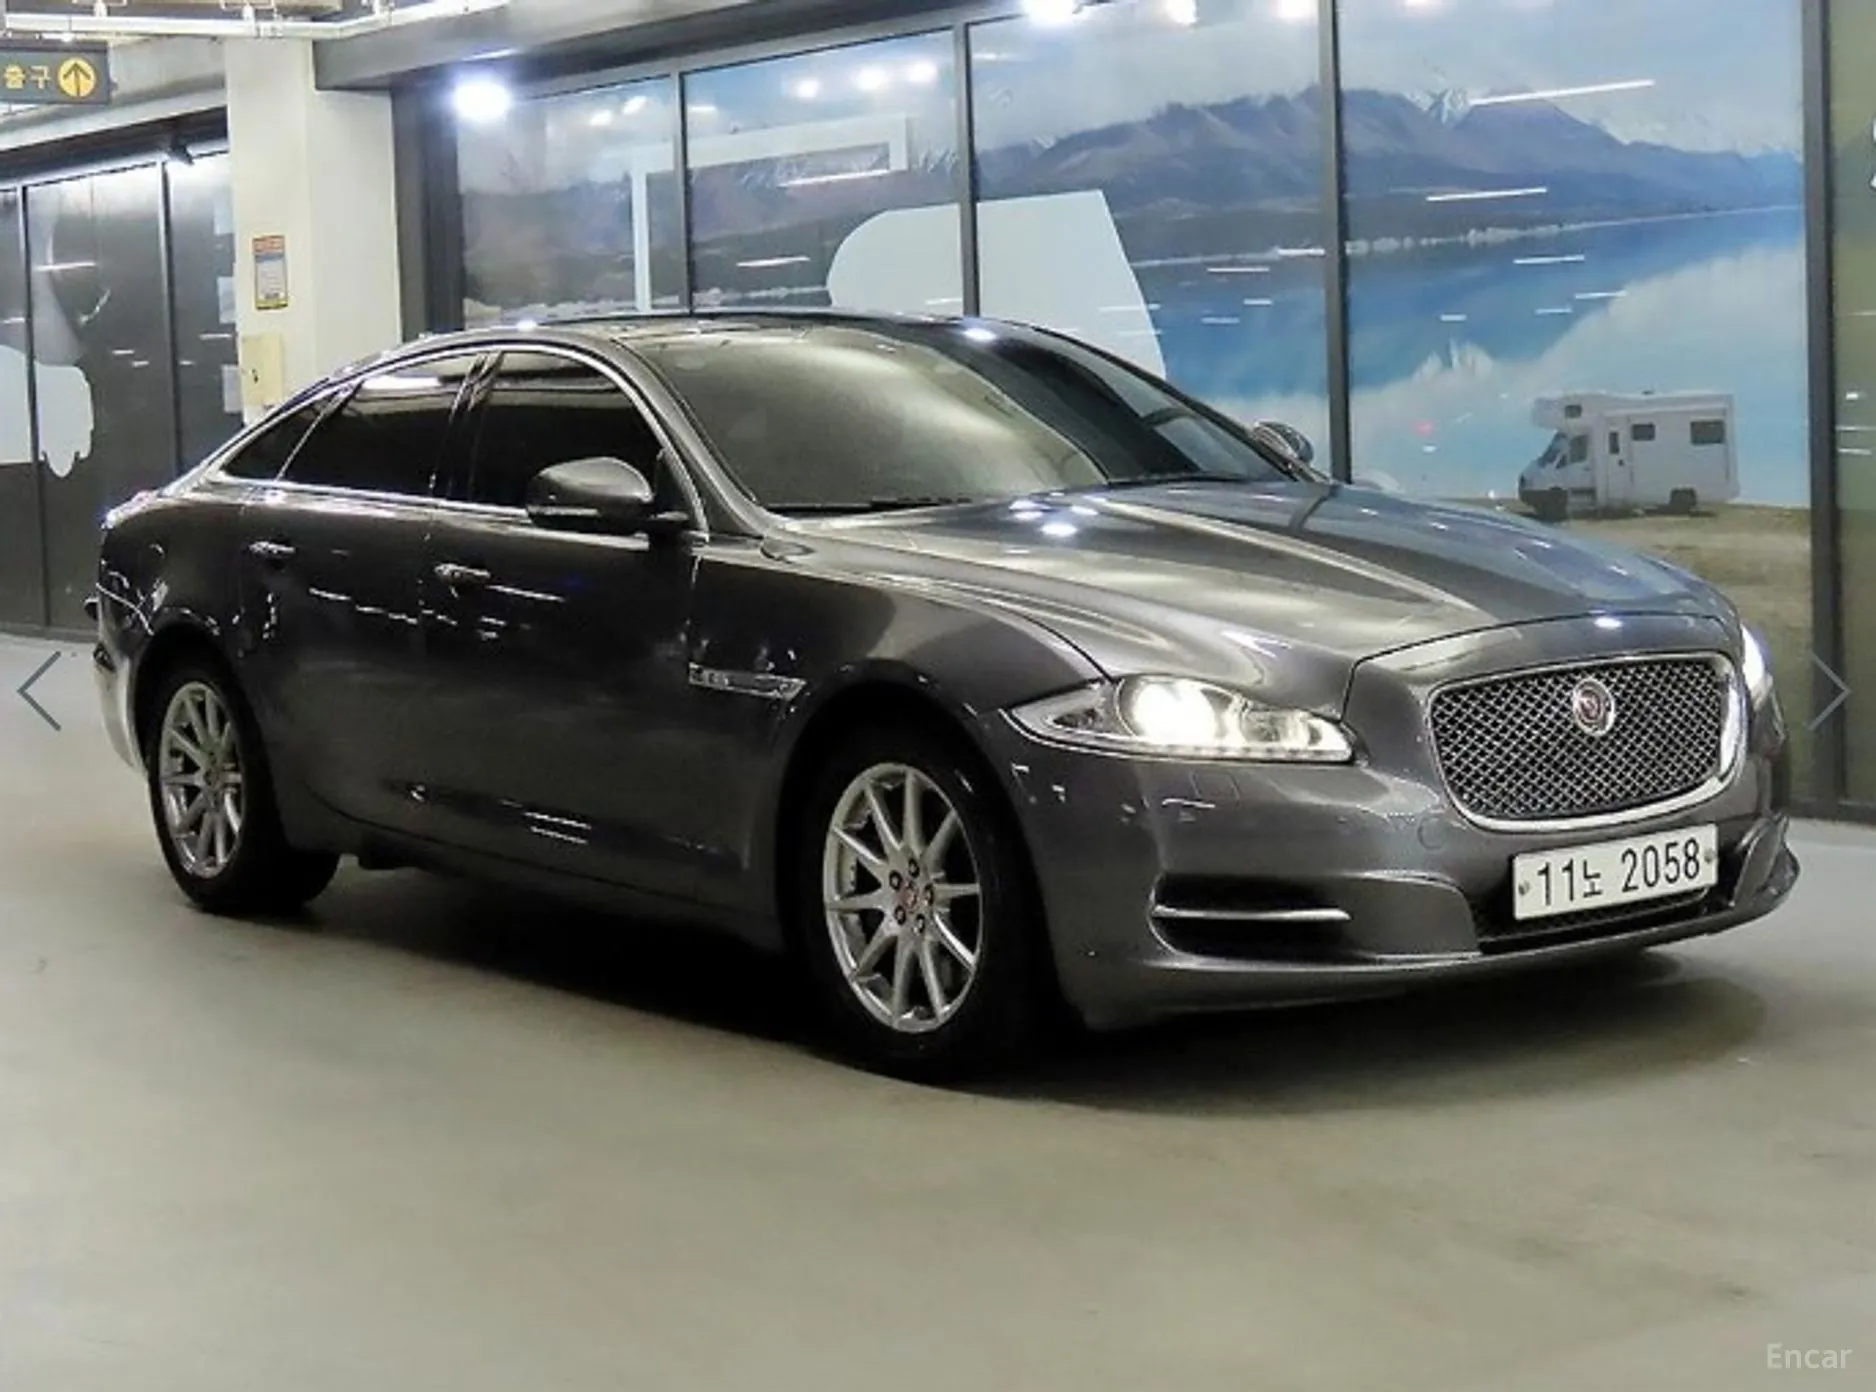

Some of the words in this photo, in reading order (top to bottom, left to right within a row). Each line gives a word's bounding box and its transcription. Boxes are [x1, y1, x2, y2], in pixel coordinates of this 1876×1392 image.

[3, 64, 51, 89] 출구
[1537, 858, 1603, 906] 11노
[1620, 837, 1700, 893] 2058
